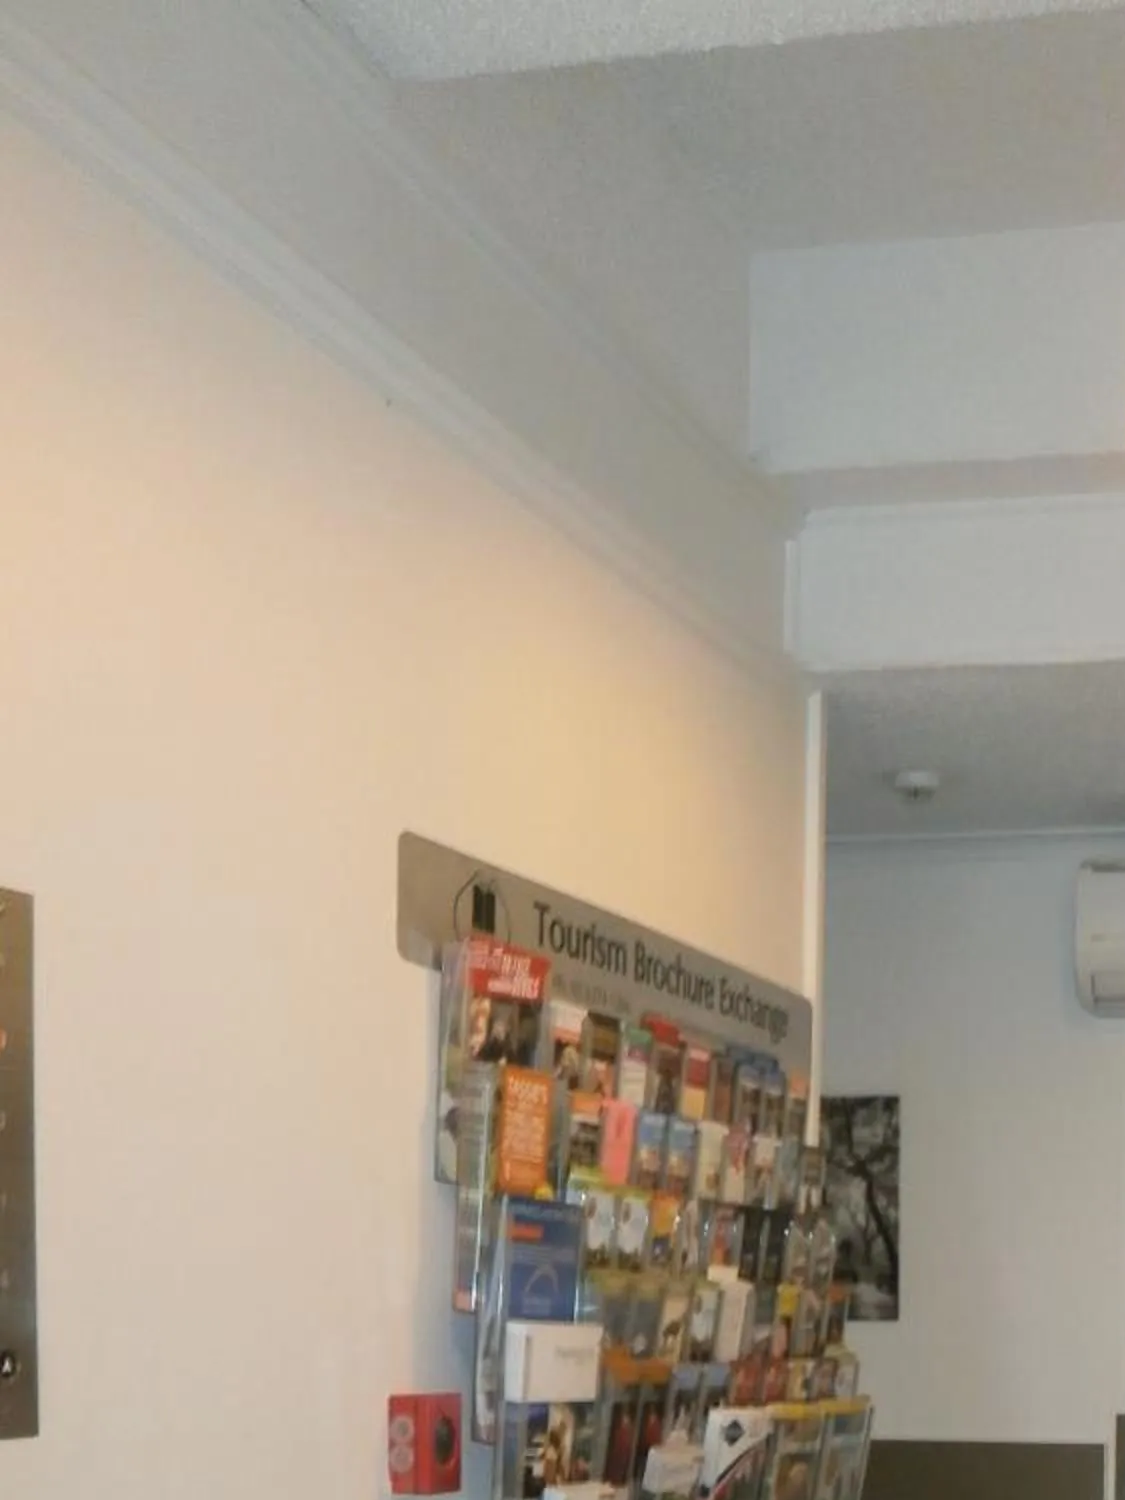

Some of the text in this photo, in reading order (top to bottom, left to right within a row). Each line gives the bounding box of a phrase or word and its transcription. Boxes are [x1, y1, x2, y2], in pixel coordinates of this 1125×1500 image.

[534, 901, 627, 976] Tourism
[634, 939, 715, 1010] Brochure
[719, 973, 789, 1044] Exchange
